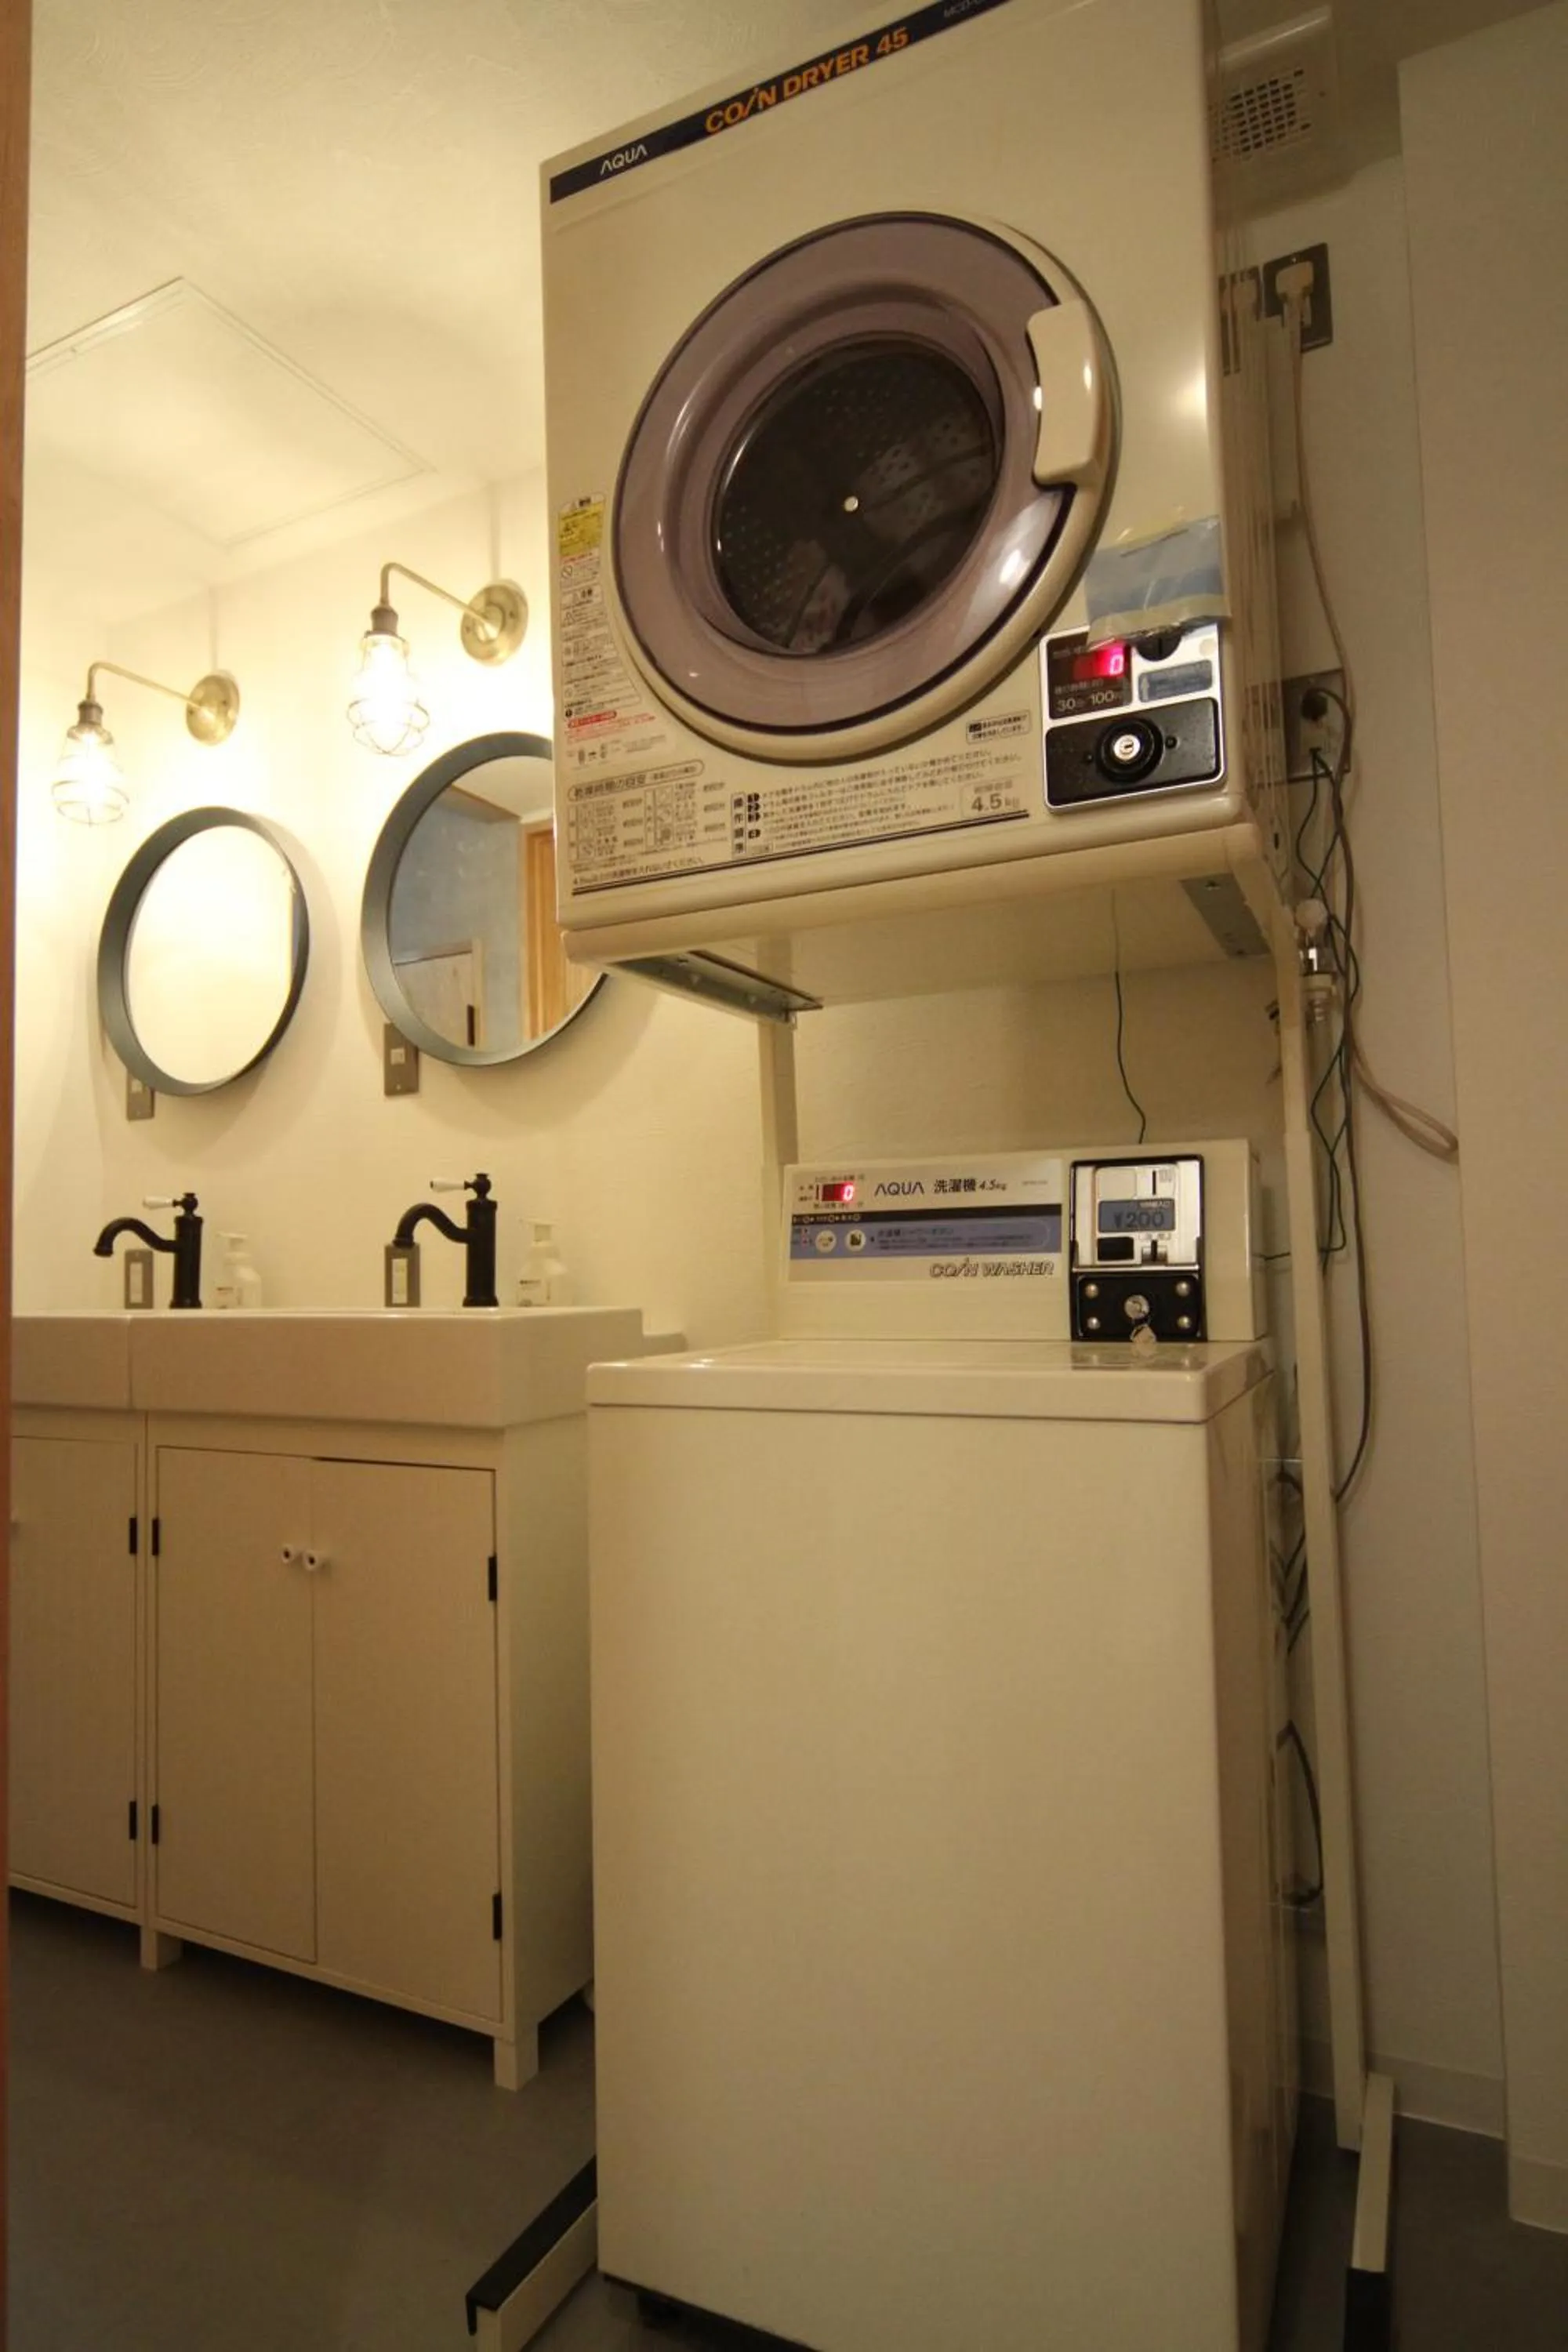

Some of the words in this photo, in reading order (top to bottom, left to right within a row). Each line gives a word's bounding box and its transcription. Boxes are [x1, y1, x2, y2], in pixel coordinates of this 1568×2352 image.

[783, 45, 869, 99] DRYER
[876, 27, 910, 56] 45
[600, 143, 647, 176] AQUA
[874, 1181, 925, 1197] AQUA
[934, 1178, 977, 1195] 洗濯機
